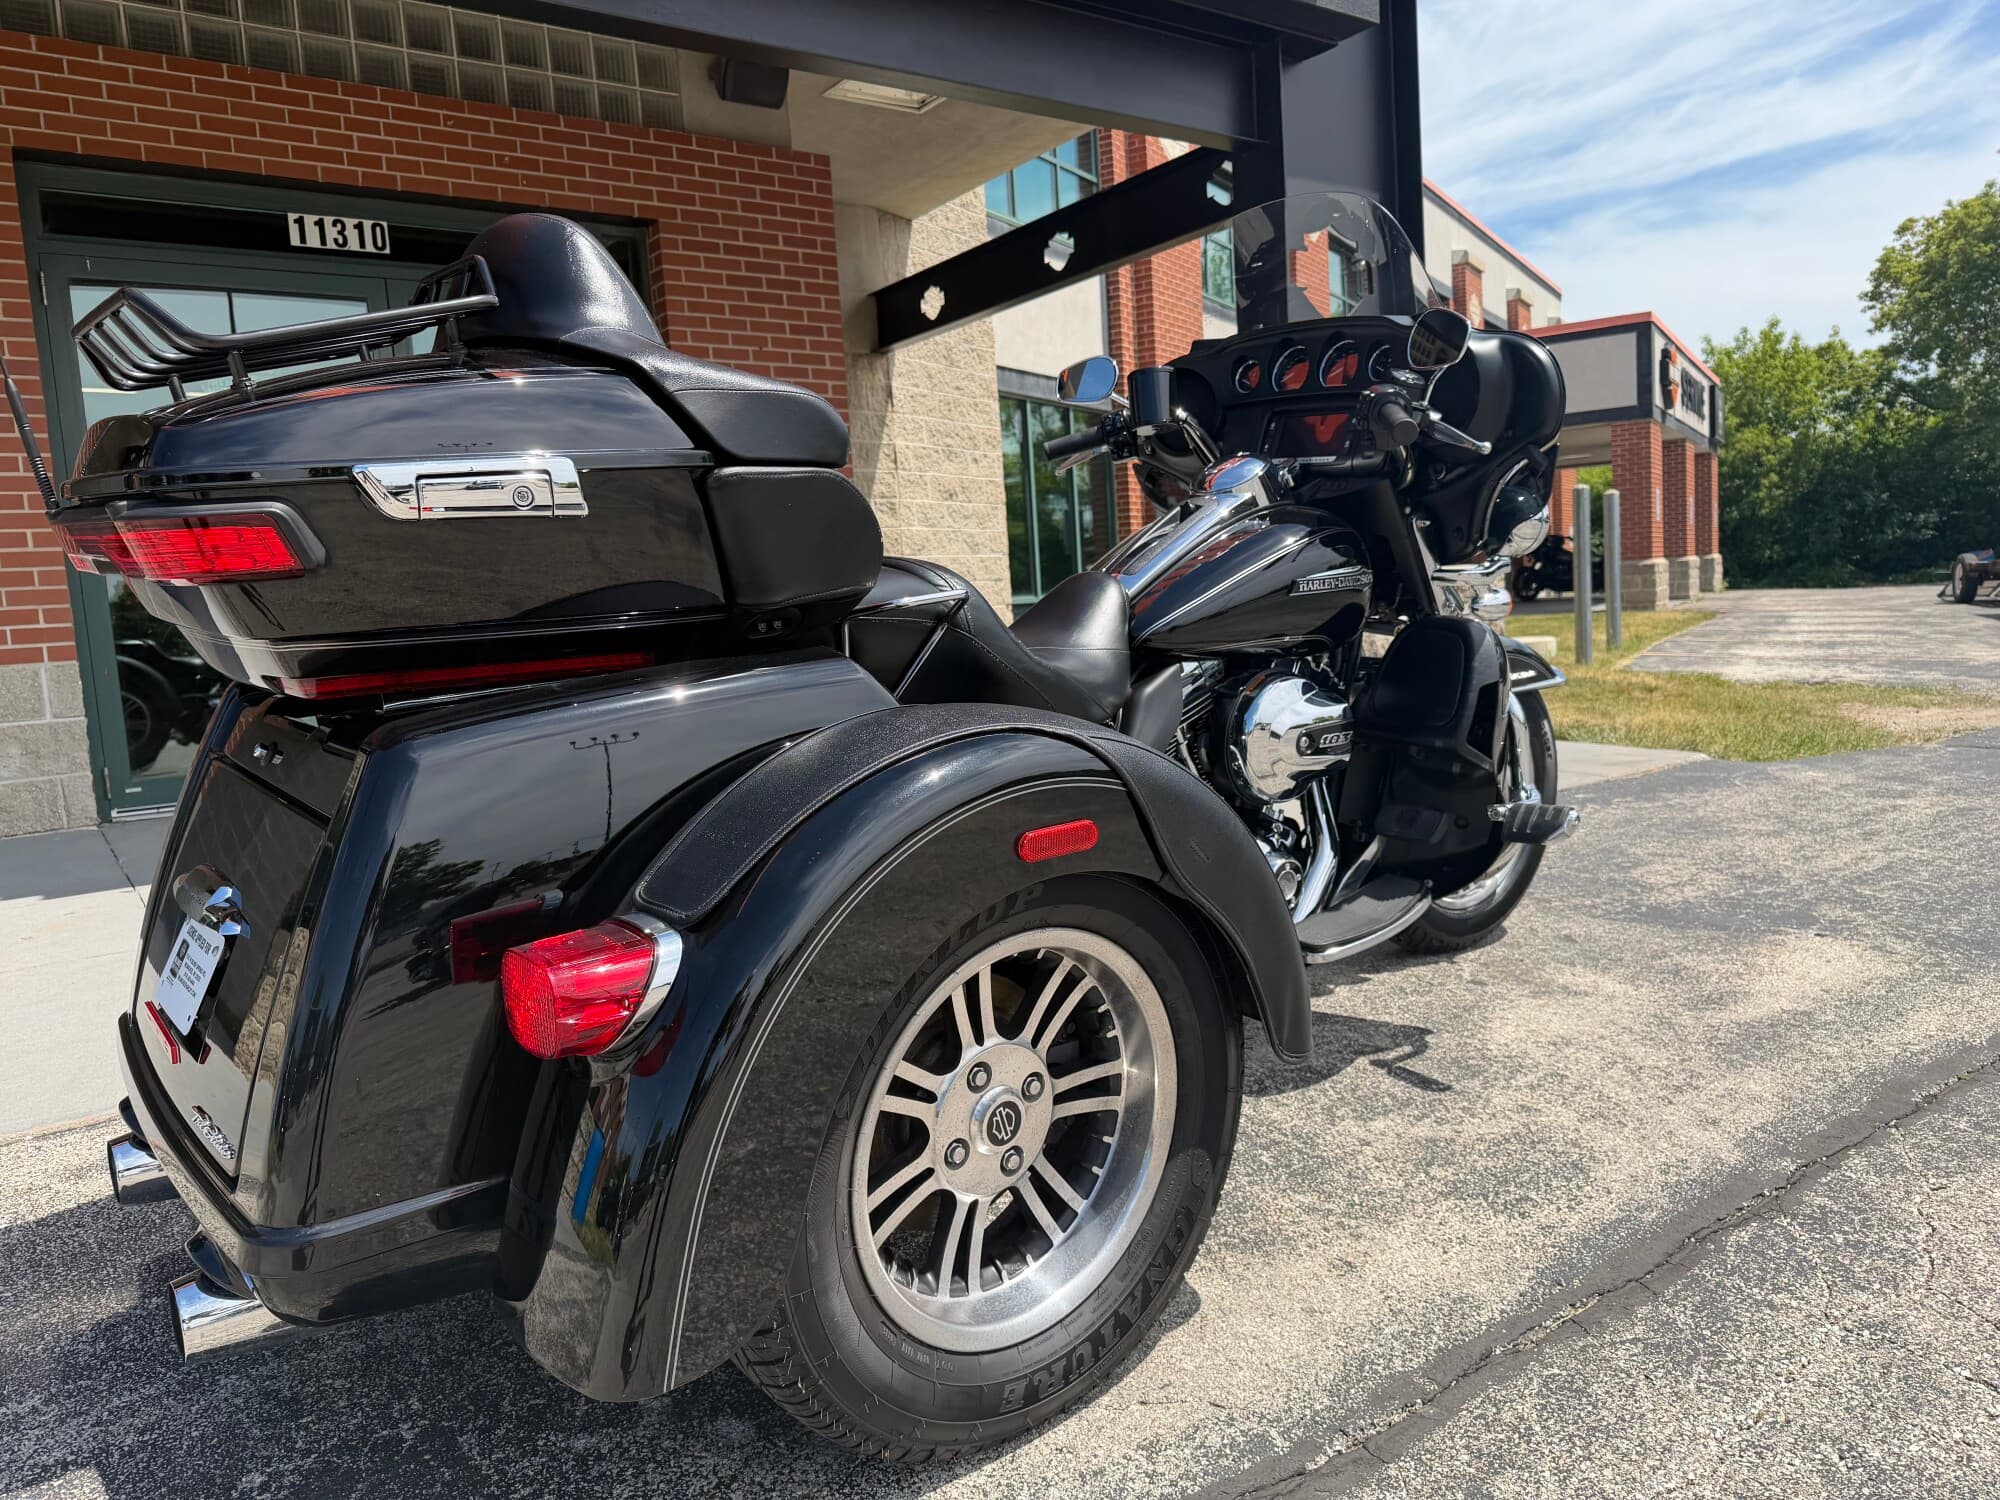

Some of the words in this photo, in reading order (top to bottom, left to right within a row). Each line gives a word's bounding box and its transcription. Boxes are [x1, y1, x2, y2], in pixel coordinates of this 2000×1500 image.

[293, 215, 387, 251] 11310
[1299, 574, 1373, 592] HARLEY-DAVIDSON
[1319, 731, 1353, 748] 103
